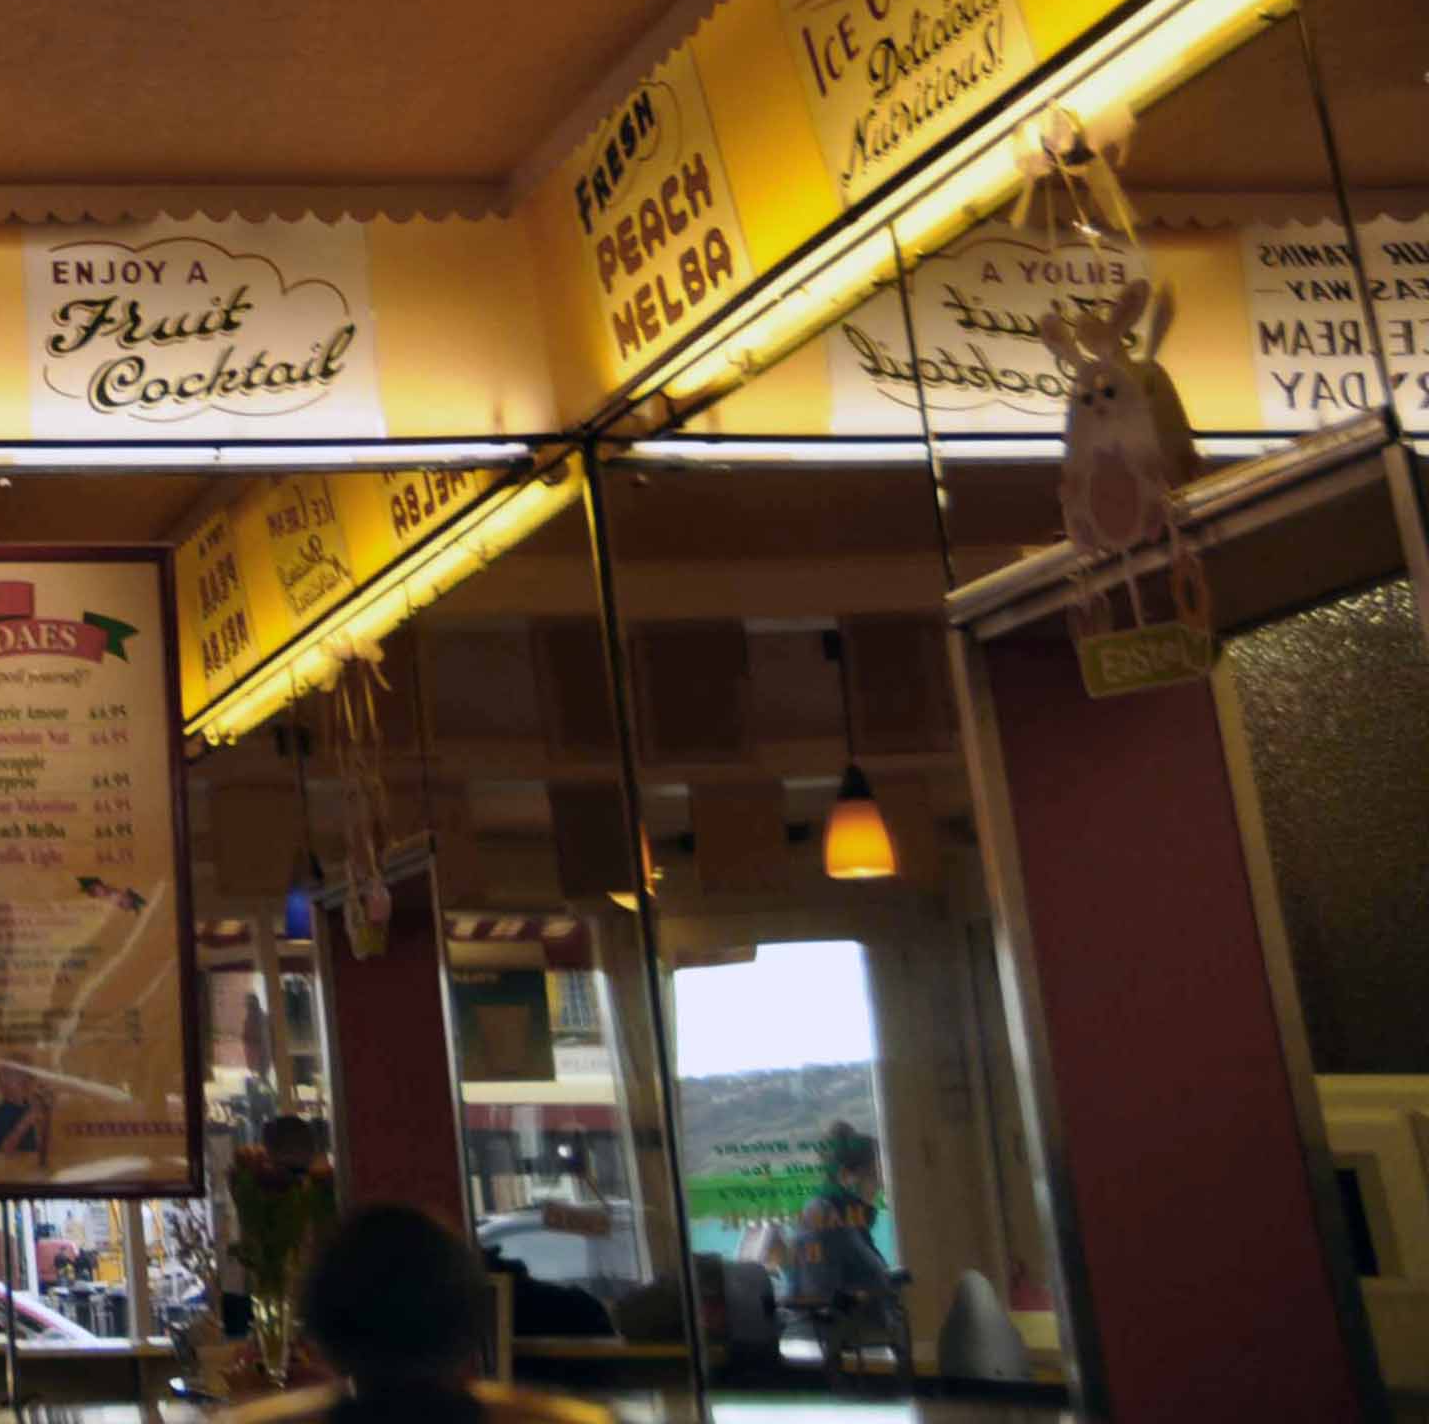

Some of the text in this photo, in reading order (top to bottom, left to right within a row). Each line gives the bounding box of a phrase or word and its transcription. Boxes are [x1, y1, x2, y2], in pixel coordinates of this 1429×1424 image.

[799, 9, 864, 100] ICE
[574, 90, 659, 238] FRESH
[595, 151, 714, 295] PEACH
[50, 258, 210, 286] ENJOY A
[611, 225, 735, 361] MELBA
[44, 283, 256, 358] Fruit
[86, 320, 359, 415] Cocktail
